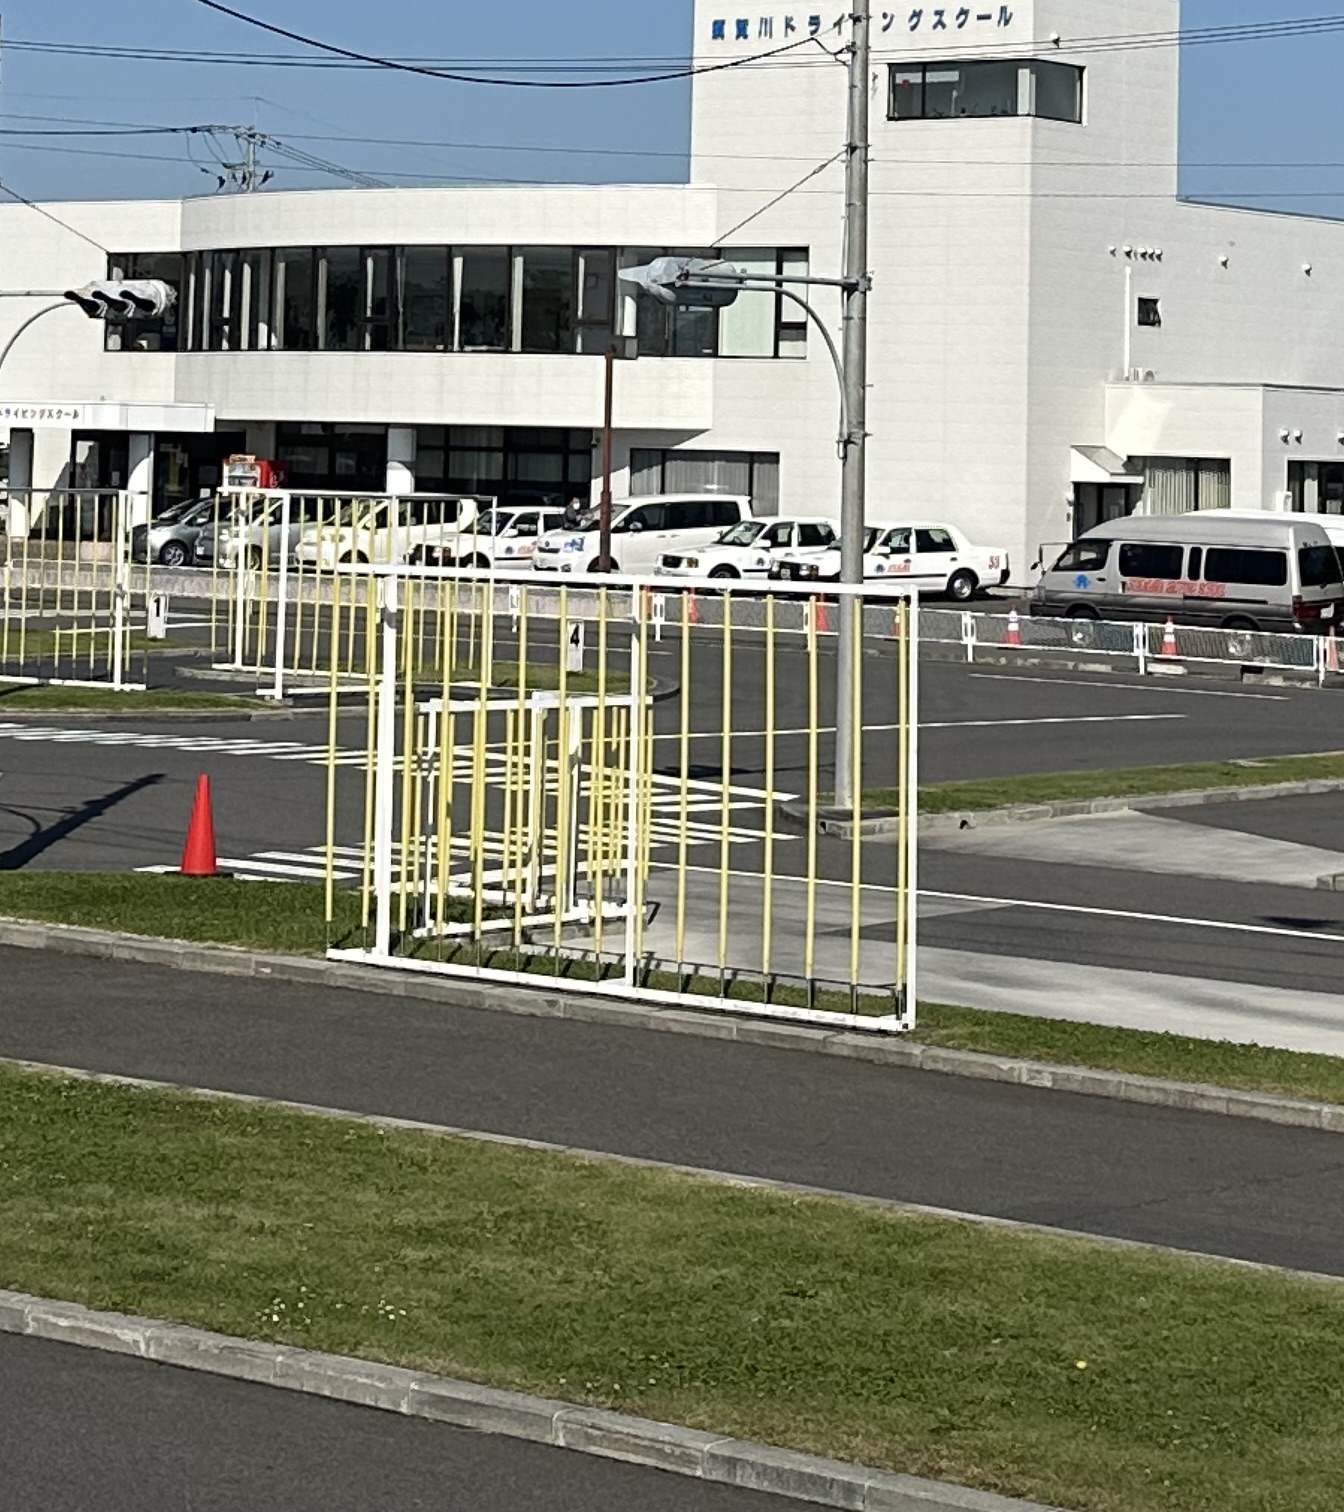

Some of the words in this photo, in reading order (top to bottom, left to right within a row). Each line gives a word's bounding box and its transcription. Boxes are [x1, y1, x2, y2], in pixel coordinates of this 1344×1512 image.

[712, 5, 1013, 40] 須賀川ドライングスクール
[153, 596, 161, 618] 1
[569, 623, 580, 647] 4
